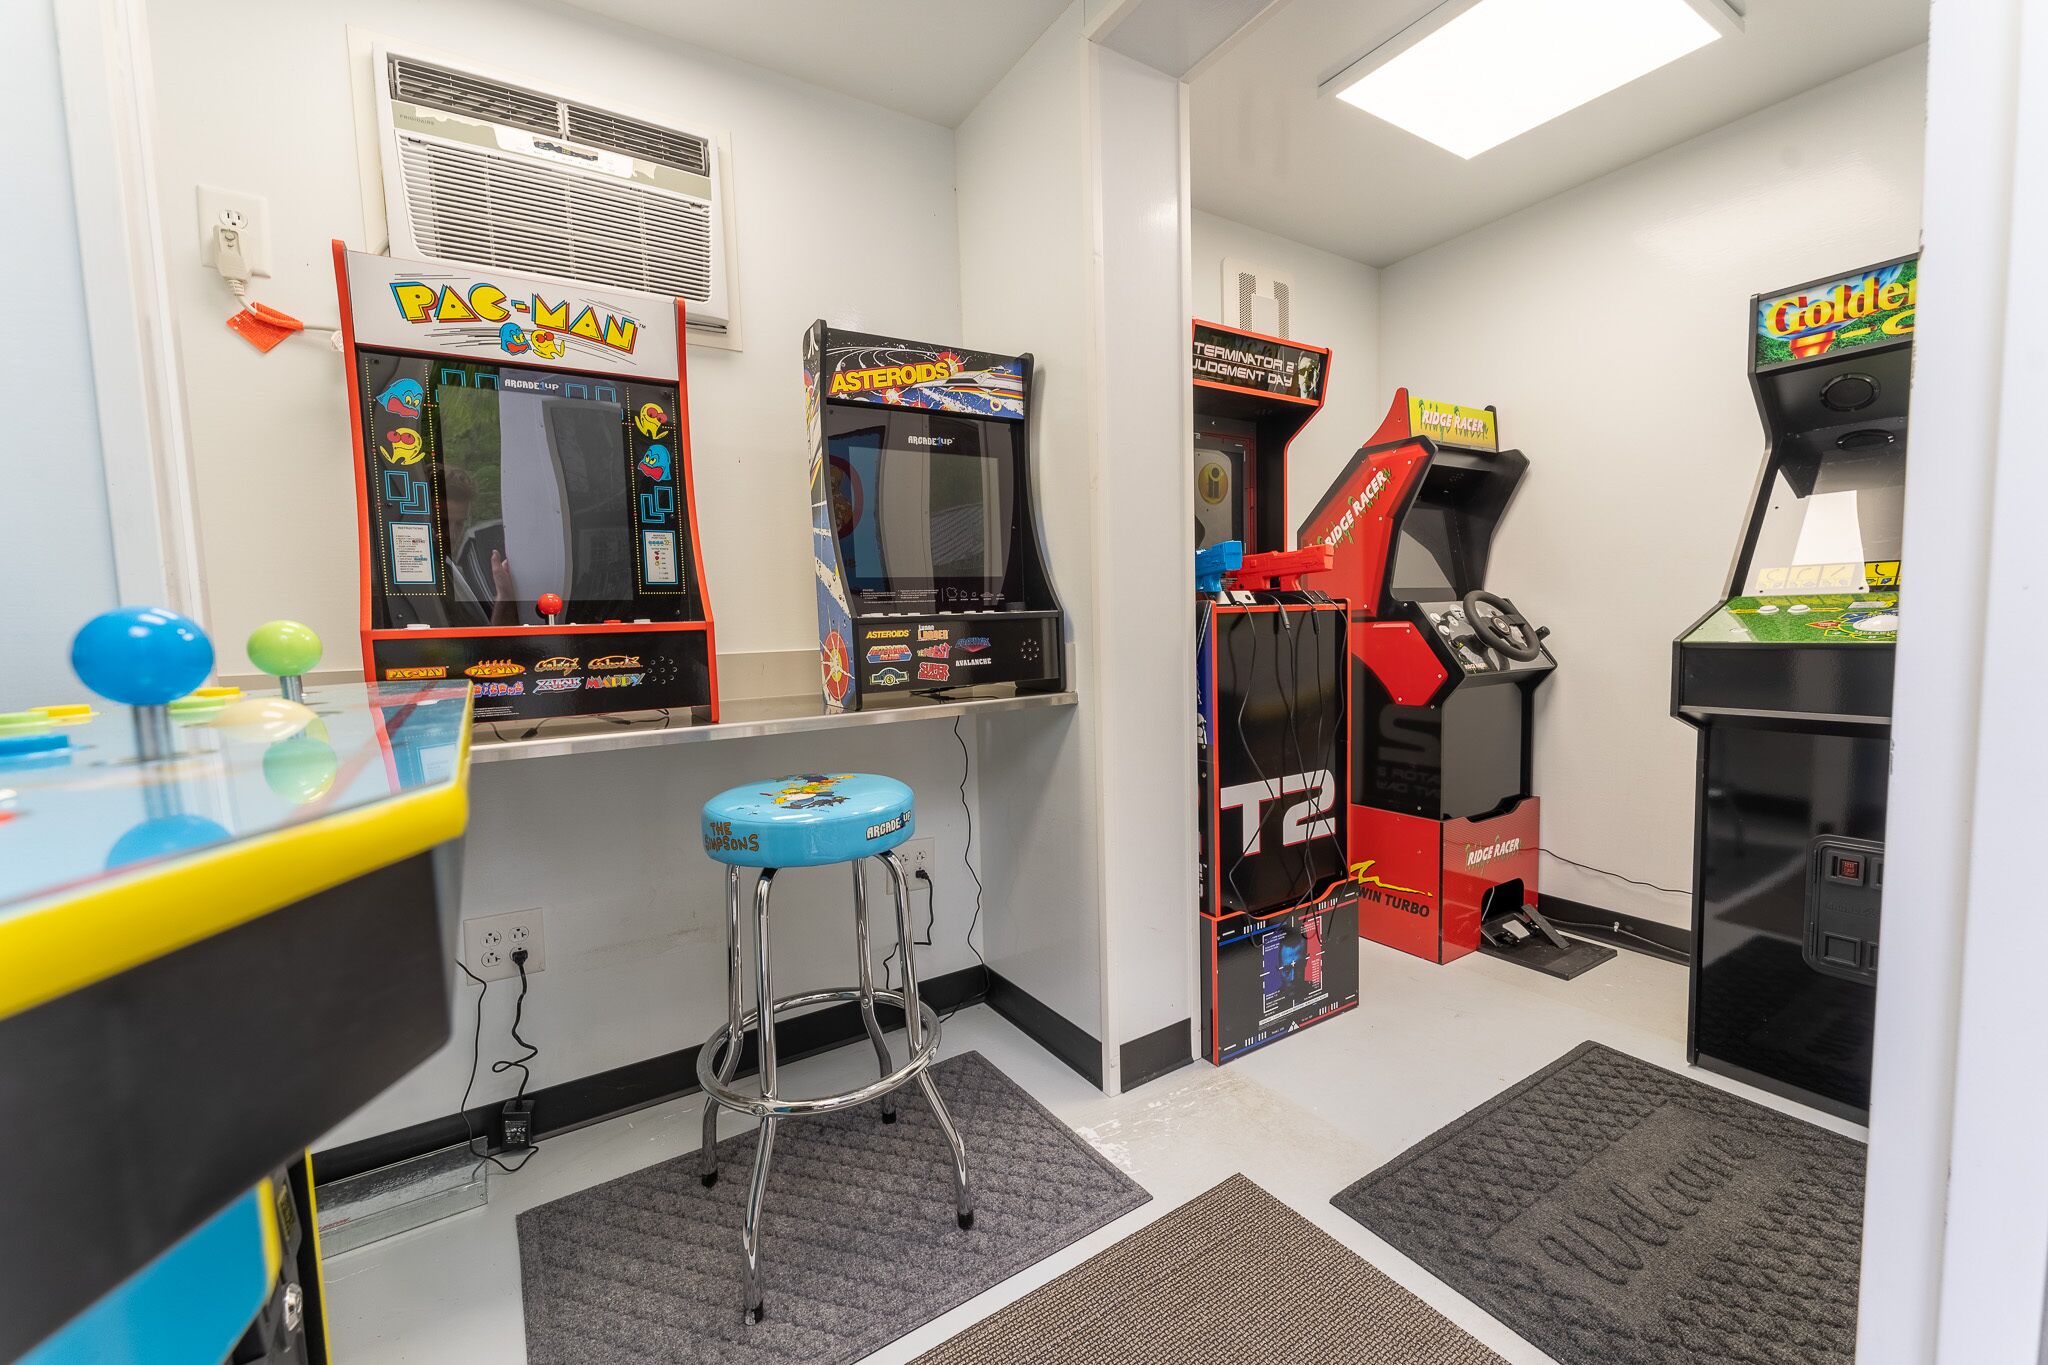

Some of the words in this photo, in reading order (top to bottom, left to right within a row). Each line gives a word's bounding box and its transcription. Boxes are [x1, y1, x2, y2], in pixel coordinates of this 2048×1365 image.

[389, 282, 638, 354] PAC-MAN
[1194, 341, 1284, 371] TERMINATOR
[1285, 361, 1294, 374] 2
[831, 362, 951, 394] ASTEROIDS
[1192, 358, 1265, 382] JUDGMENT
[1267, 373, 1293, 387] DAY
[1421, 409, 1453, 427] RIDGE
[1453, 414, 1485, 433] RACER
[1324, 510, 1355, 546] RIDGE
[1353, 470, 1387, 516] RACER
[866, 629, 910, 640] ASTEROIDS
[388, 668, 444, 679] PAC-MAN
[955, 657, 992, 667] AVALANCHE
[585, 672, 646, 690] MAPPY
[1220, 769, 1336, 857] T2
[704, 833, 760, 852] SIMPSONS
[709, 821, 732, 837] THE
[1466, 845, 1494, 867] RIDGE
[1493, 838, 1521, 858] RACER
[1359, 886, 1382, 904] WIN
[1385, 893, 1430, 918] TURBO
